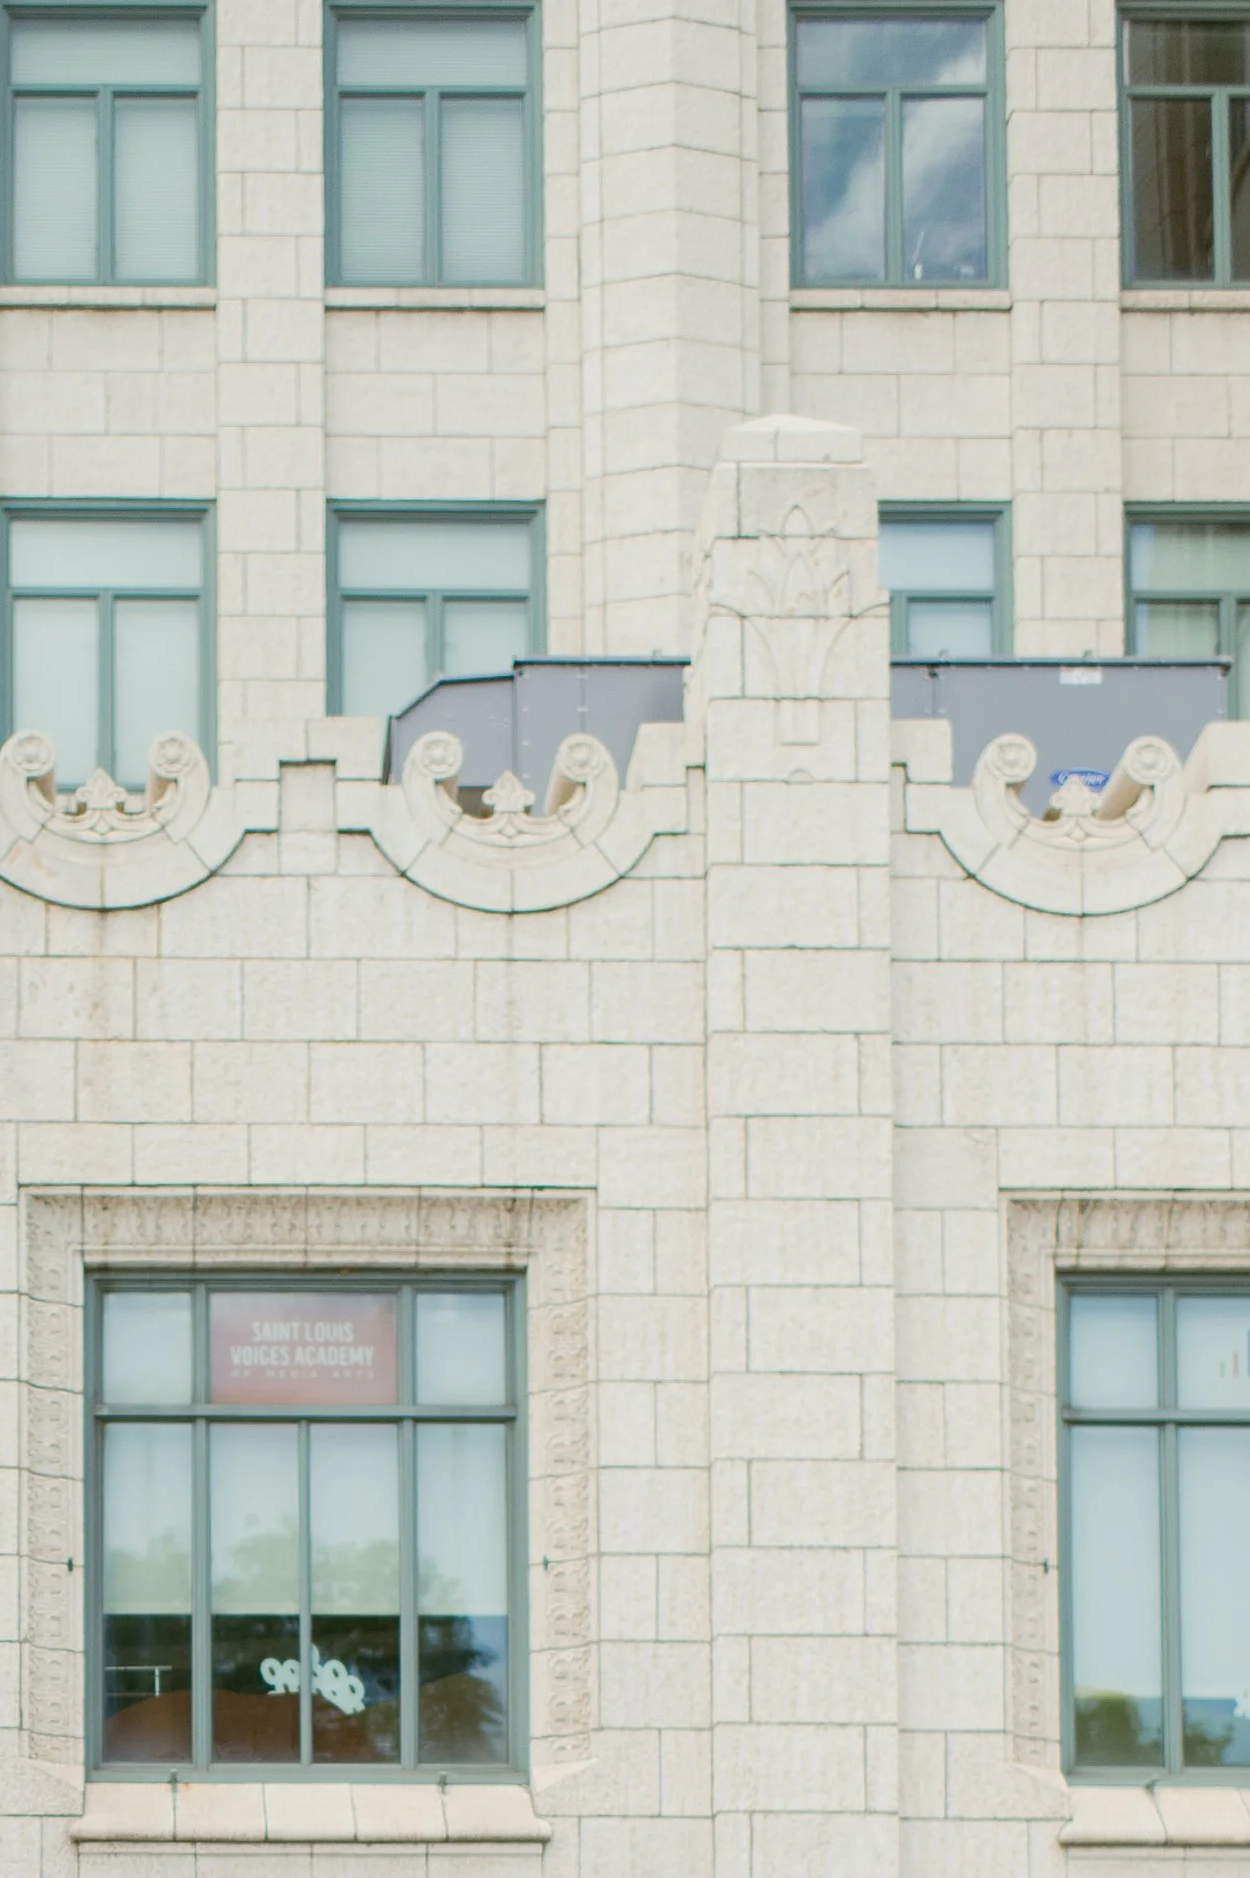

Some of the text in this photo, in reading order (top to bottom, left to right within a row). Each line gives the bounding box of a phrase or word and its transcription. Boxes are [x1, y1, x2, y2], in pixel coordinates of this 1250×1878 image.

[251, 1321, 354, 1342] SAINT LOUIS
[230, 1345, 375, 1367] VOICES ACADEMY
